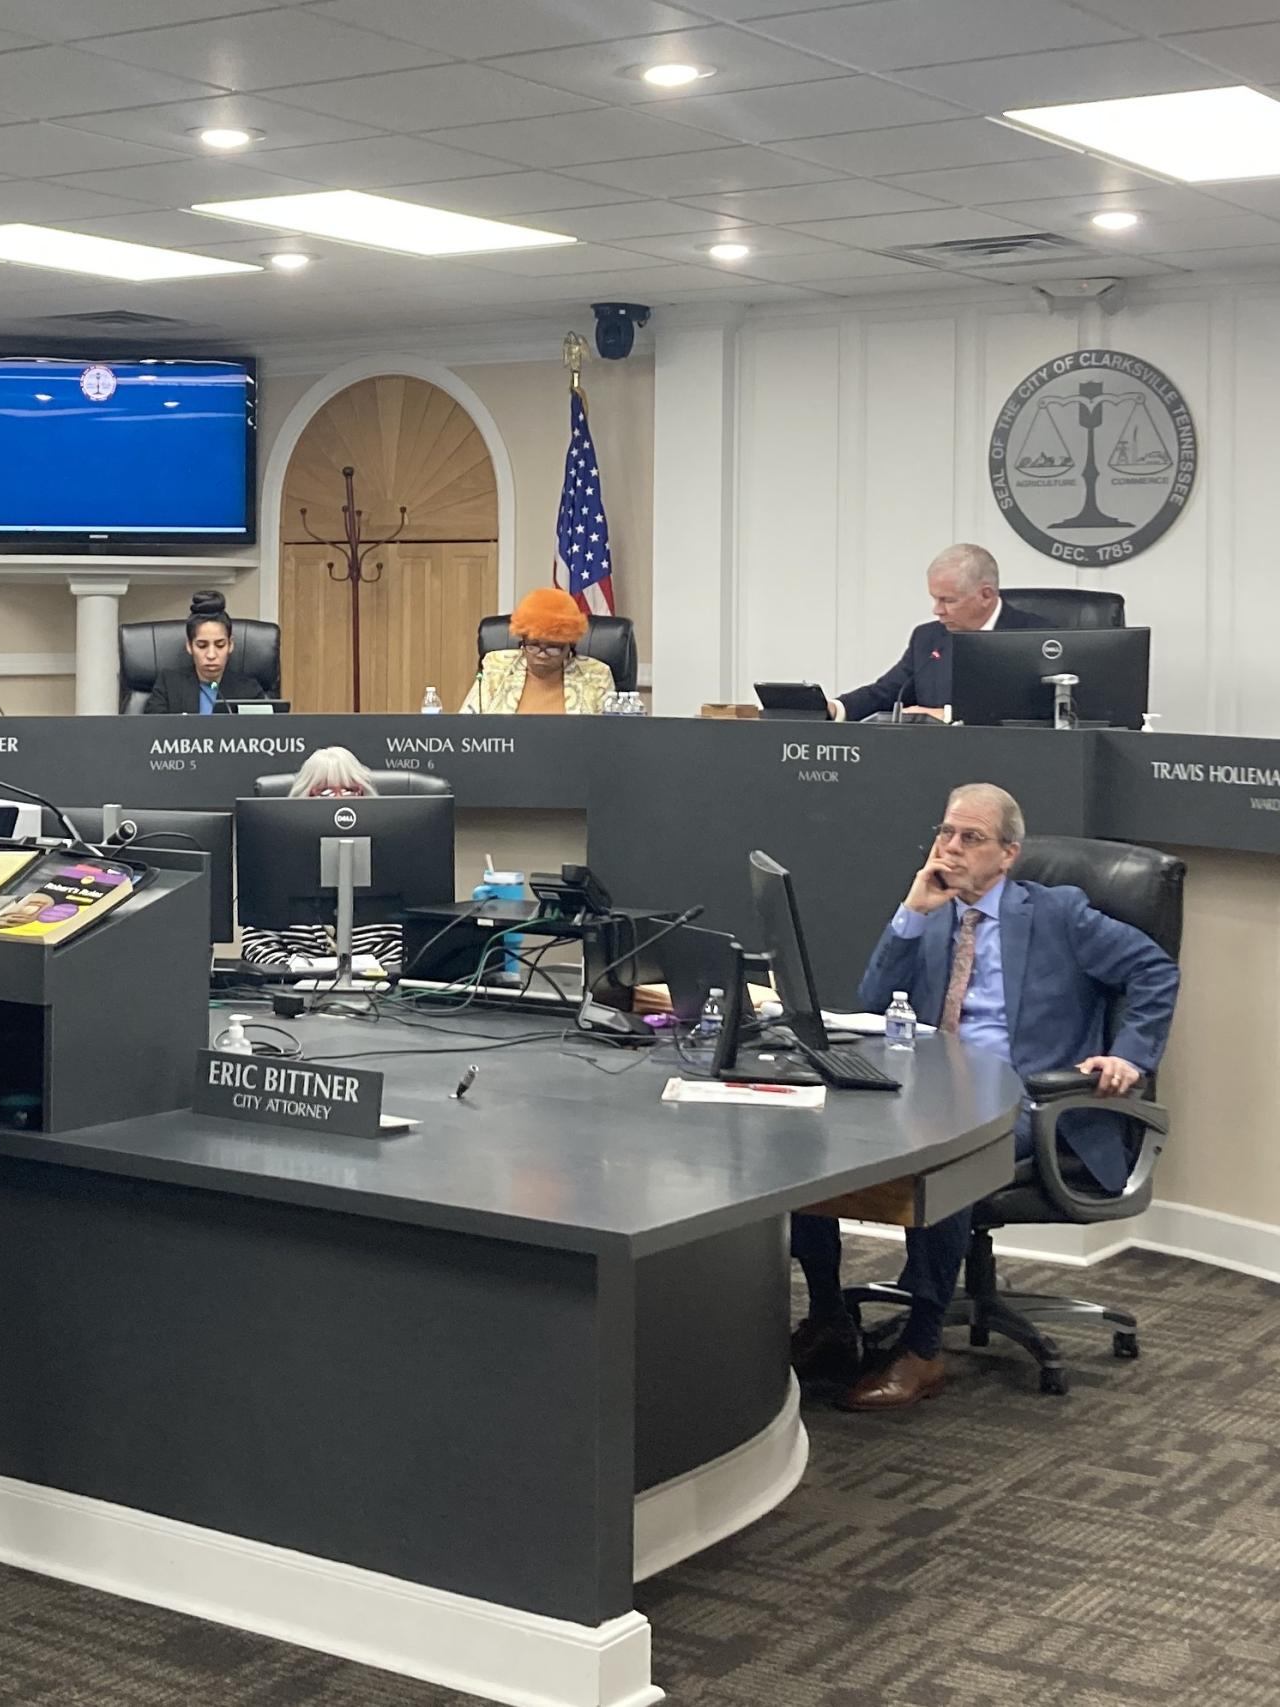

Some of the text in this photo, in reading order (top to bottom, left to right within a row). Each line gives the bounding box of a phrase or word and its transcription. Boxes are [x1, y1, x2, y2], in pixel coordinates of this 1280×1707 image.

[992, 352, 1194, 510] SEAL OF THE CITY OF CLARKSVILLE TENNESSEE
[1111, 477, 1169, 486] COMMERCE
[1051, 540, 1134, 562] DEC. 1785
[150, 737, 305, 756] AMBAR MARQUIS
[386, 737, 515, 753] WANDA SMITH
[781, 743, 860, 763] JOE PITTS
[149, 759, 197, 771] WARD 5
[384, 758, 434, 770] WARD 6
[1151, 761, 1204, 781] TRAVIS
[798, 770, 839, 783] MAYOR
[1250, 797, 1280, 811] WARD
[209, 1060, 359, 1103] ERIC BITTNER
[233, 1093, 332, 1120] CITY ATTORNEY
